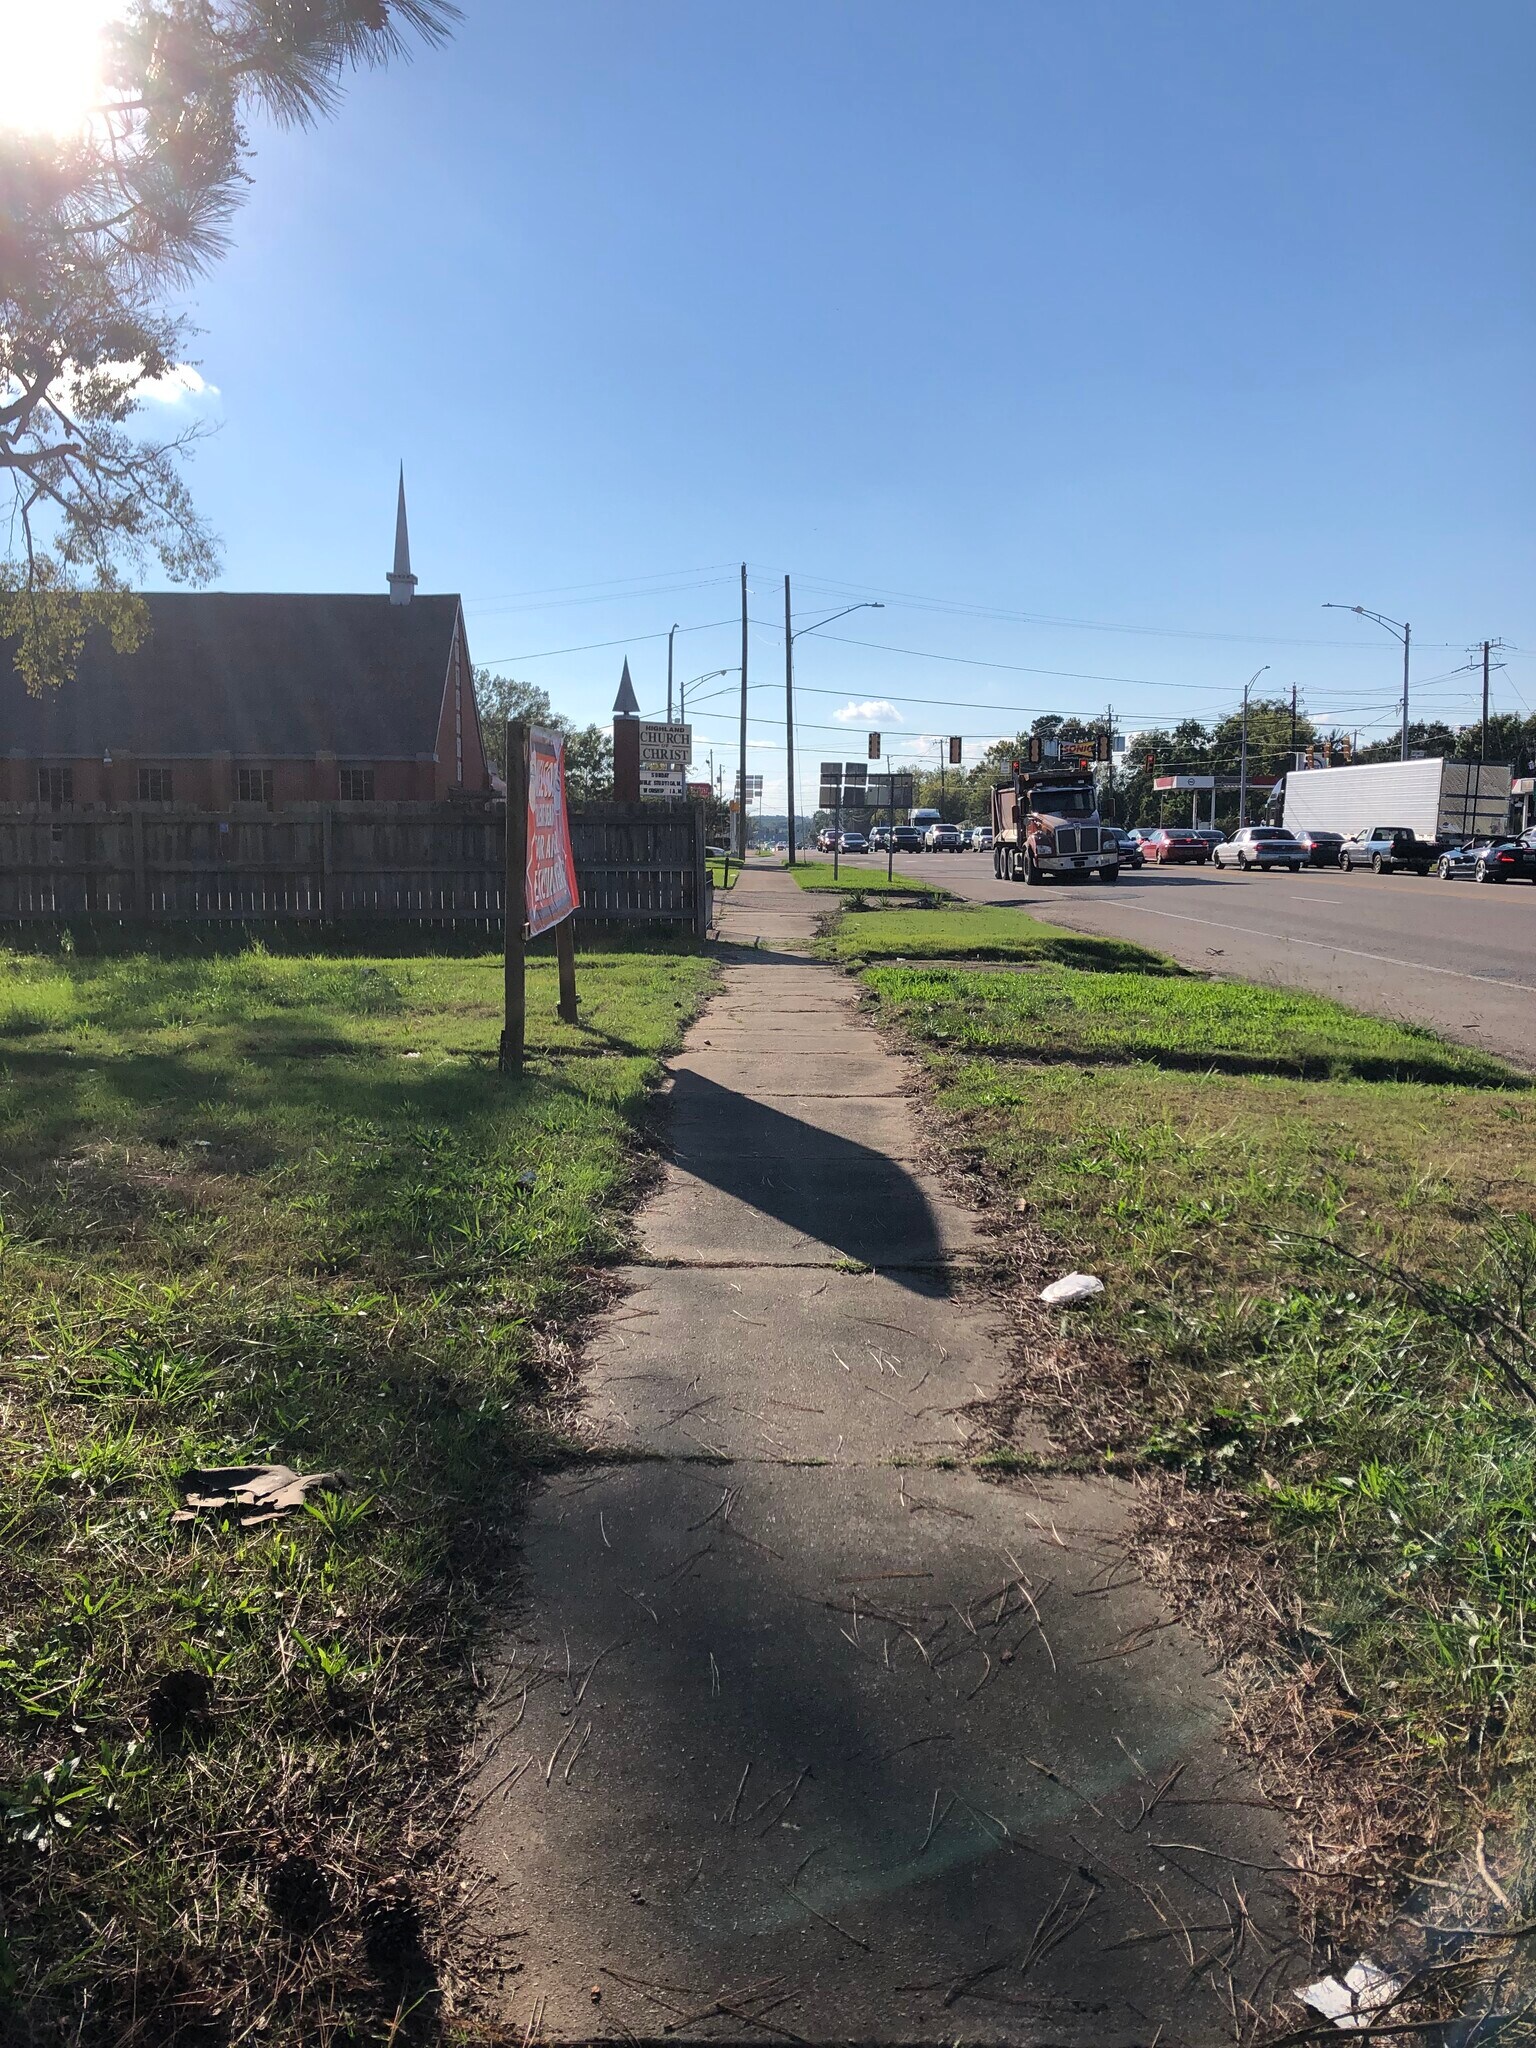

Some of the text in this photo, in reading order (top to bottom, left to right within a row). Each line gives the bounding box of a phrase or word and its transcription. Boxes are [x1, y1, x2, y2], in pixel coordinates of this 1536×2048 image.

[645, 725, 685, 733] HIGHLAND
[640, 731, 690, 745] CHURCH
[642, 747, 689, 761] CHRIST
[1063, 744, 1093, 753] SONIC
